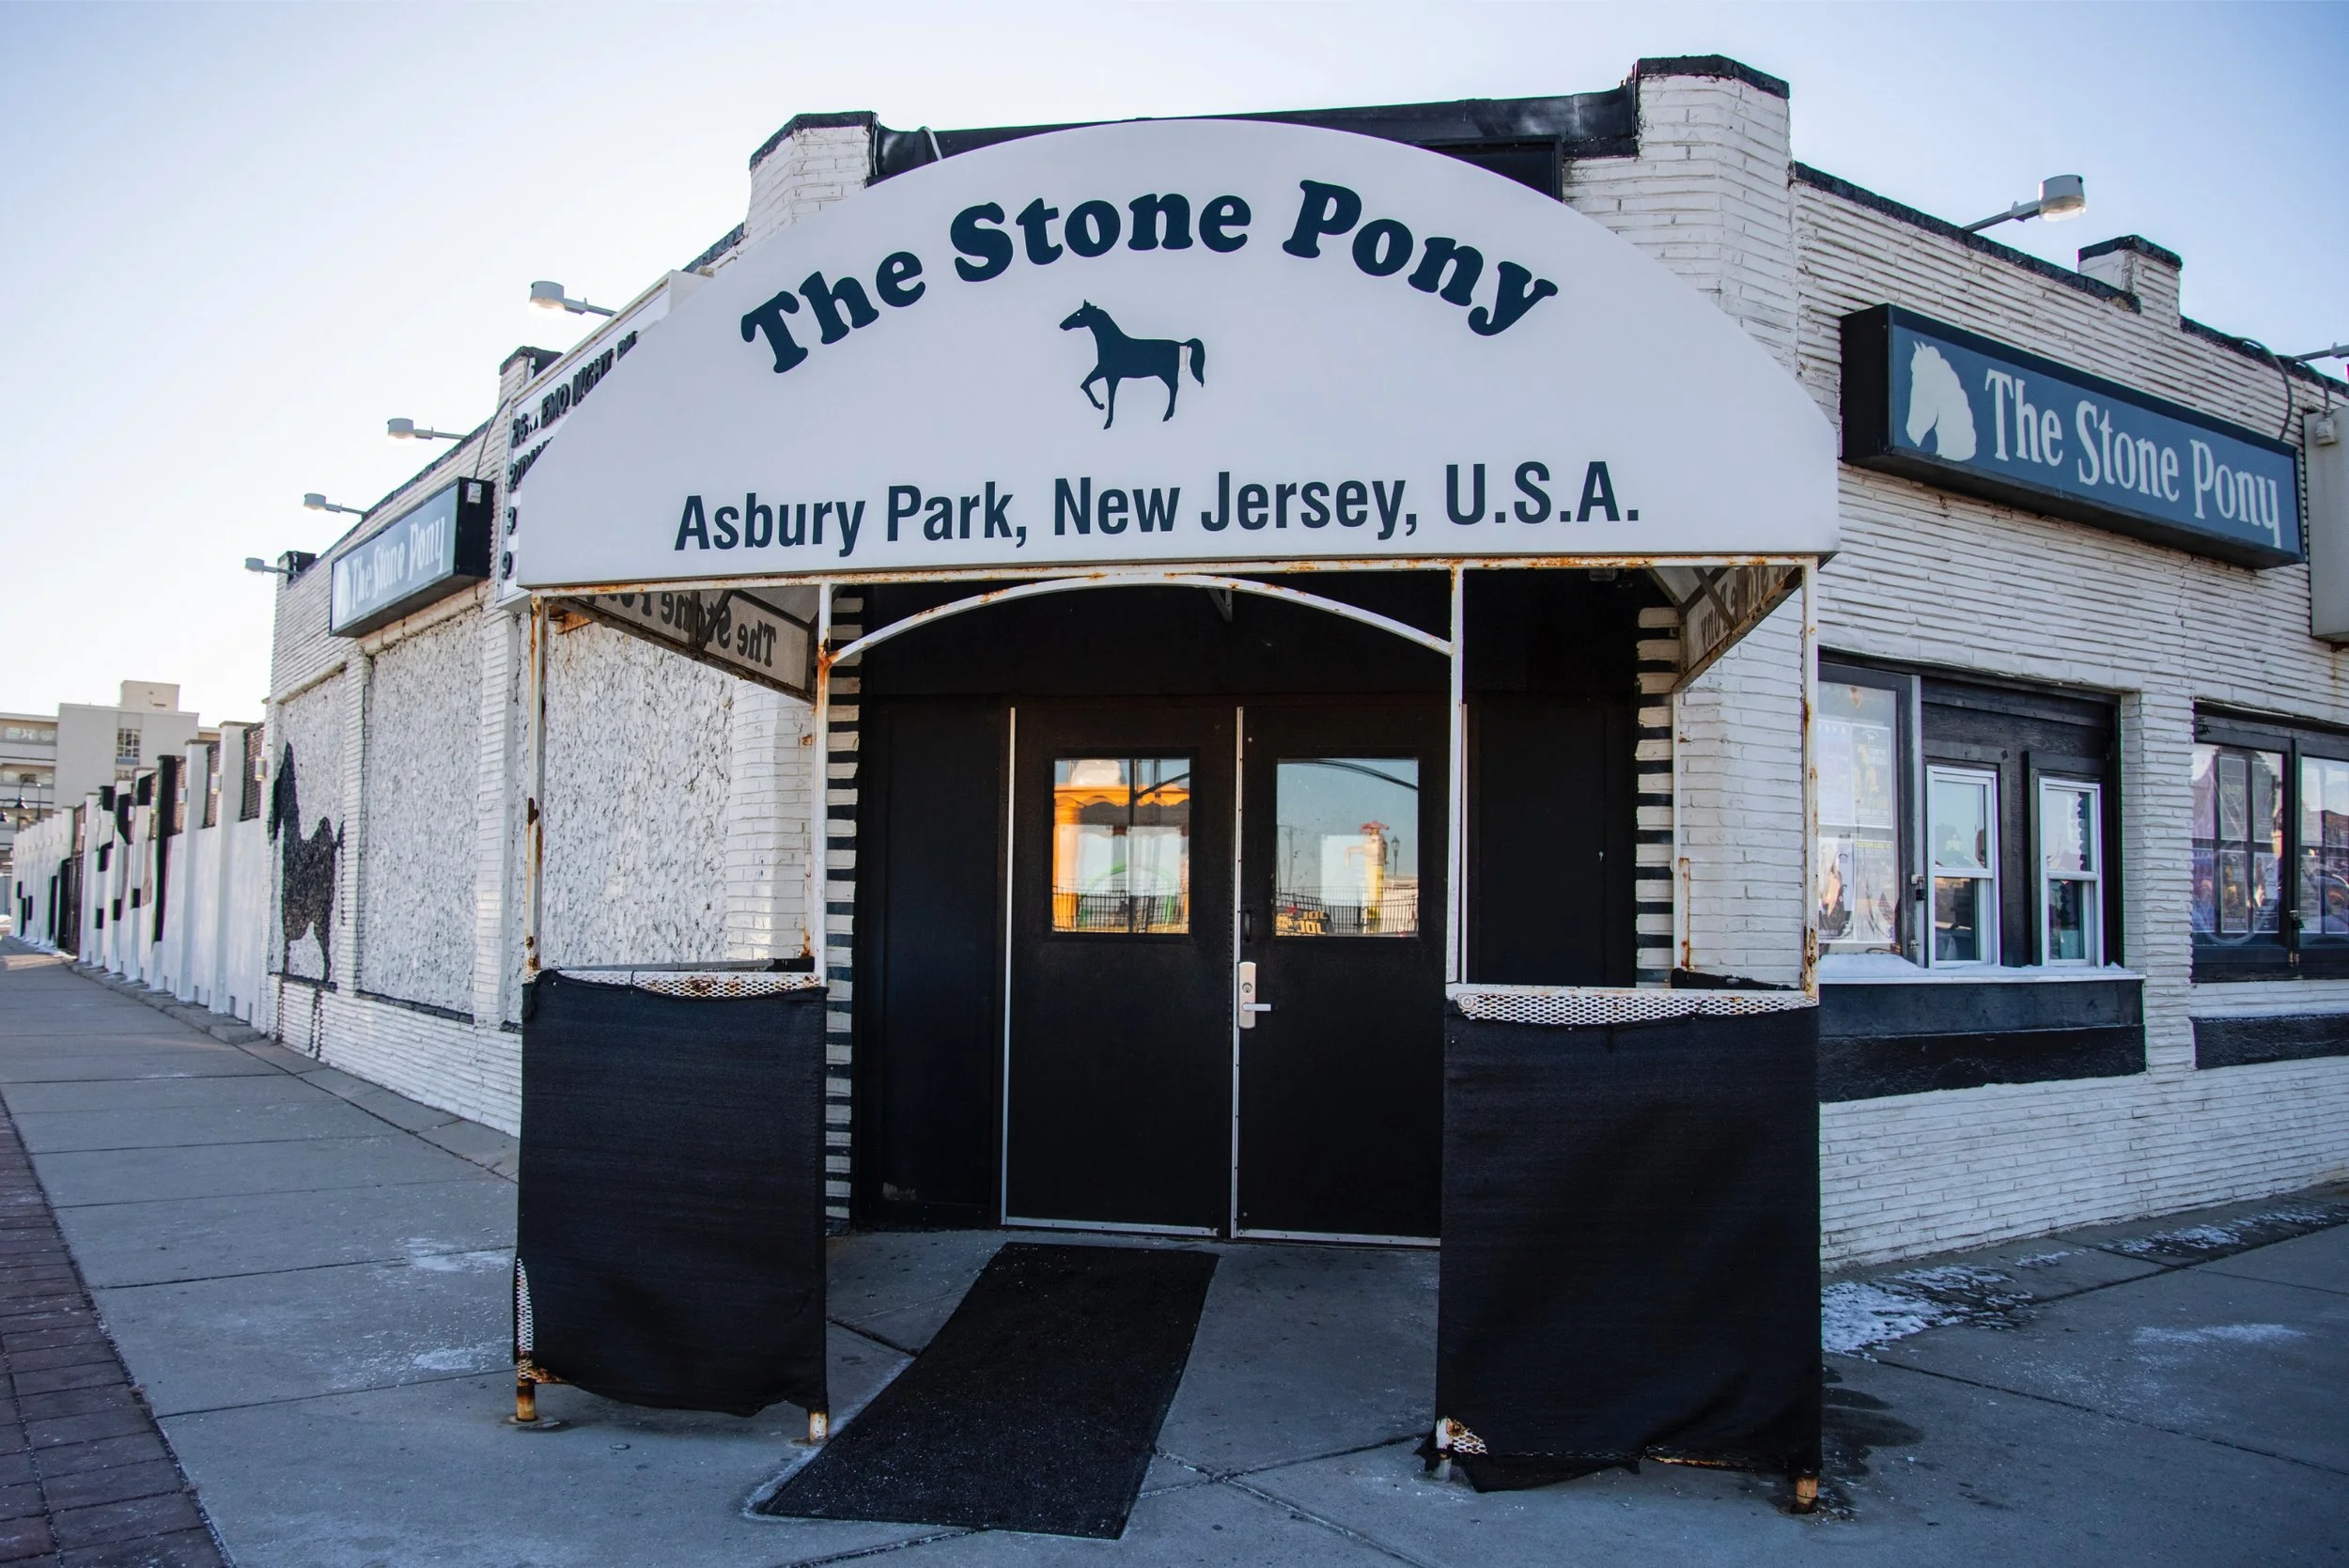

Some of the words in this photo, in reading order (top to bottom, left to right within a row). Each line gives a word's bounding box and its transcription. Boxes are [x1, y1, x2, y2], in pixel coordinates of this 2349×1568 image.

[741, 251, 926, 374] The
[950, 194, 1251, 283] Stone
[1283, 179, 1559, 337] Pony
[511, 413, 528, 448] 26
[541, 383, 570, 428] EMO
[1984, 367, 2063, 467] The
[2076, 399, 2181, 503] Stone
[2189, 439, 2281, 550] Pony
[675, 493, 866, 558] Asbury
[888, 480, 1027, 549] Park,
[1055, 476, 1181, 536] New
[1201, 471, 1418, 542] Jersey,
[1447, 460, 1640, 526] U.S.A.
[351, 555, 372, 610] The
[372, 541, 405, 599] Stone
[407, 517, 445, 582] Pony
